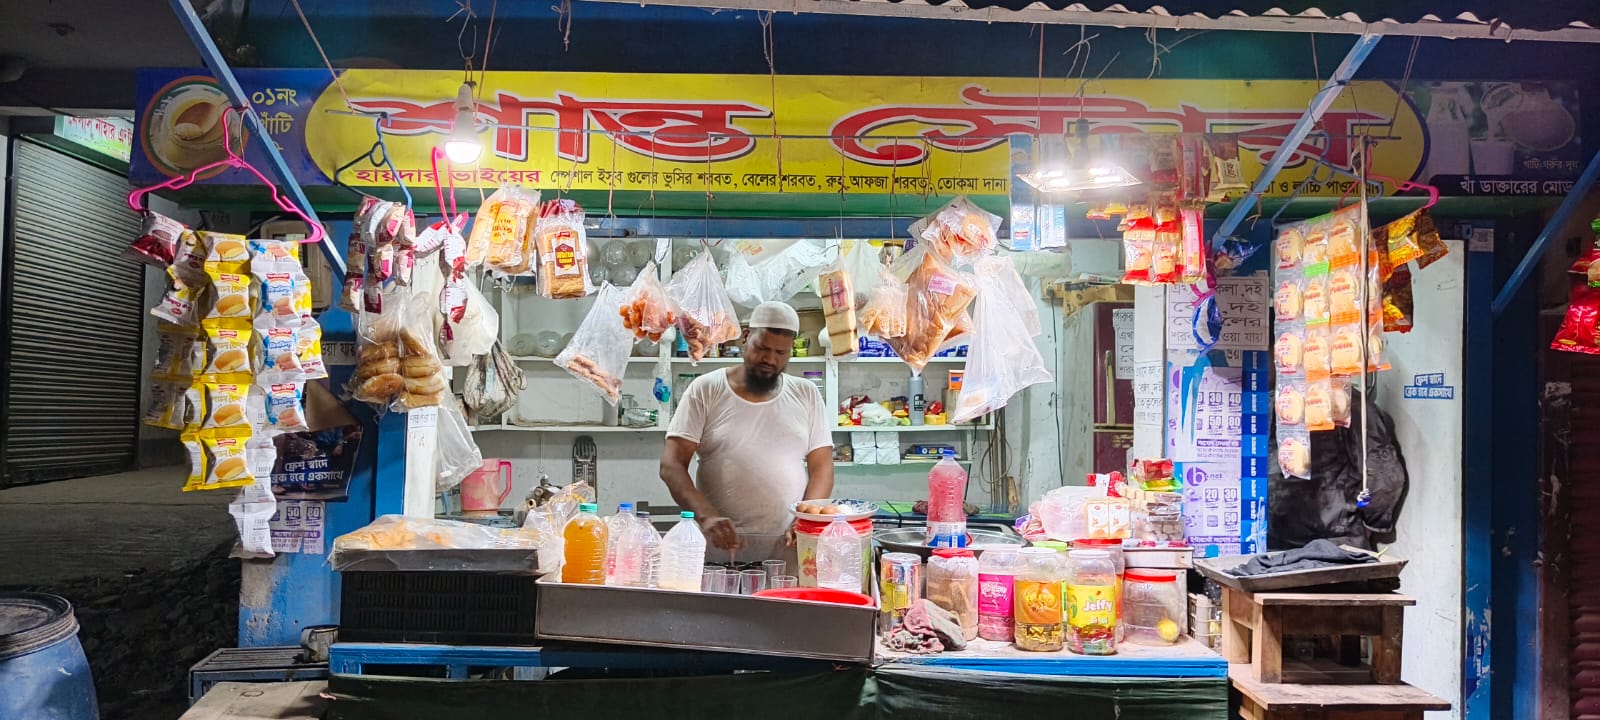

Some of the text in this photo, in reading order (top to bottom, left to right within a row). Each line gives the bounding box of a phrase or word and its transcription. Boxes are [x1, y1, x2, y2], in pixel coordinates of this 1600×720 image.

[252, 88, 299, 107] ০১নং
[451, 170, 543, 183] ভাইয়ের
[849, 175, 888, 189] আফজা
[937, 177, 978, 191] তোকমা
[983, 177, 1008, 192] দানা
[1280, 182, 1289, 193] ও
[287, 507, 299, 517] 50
